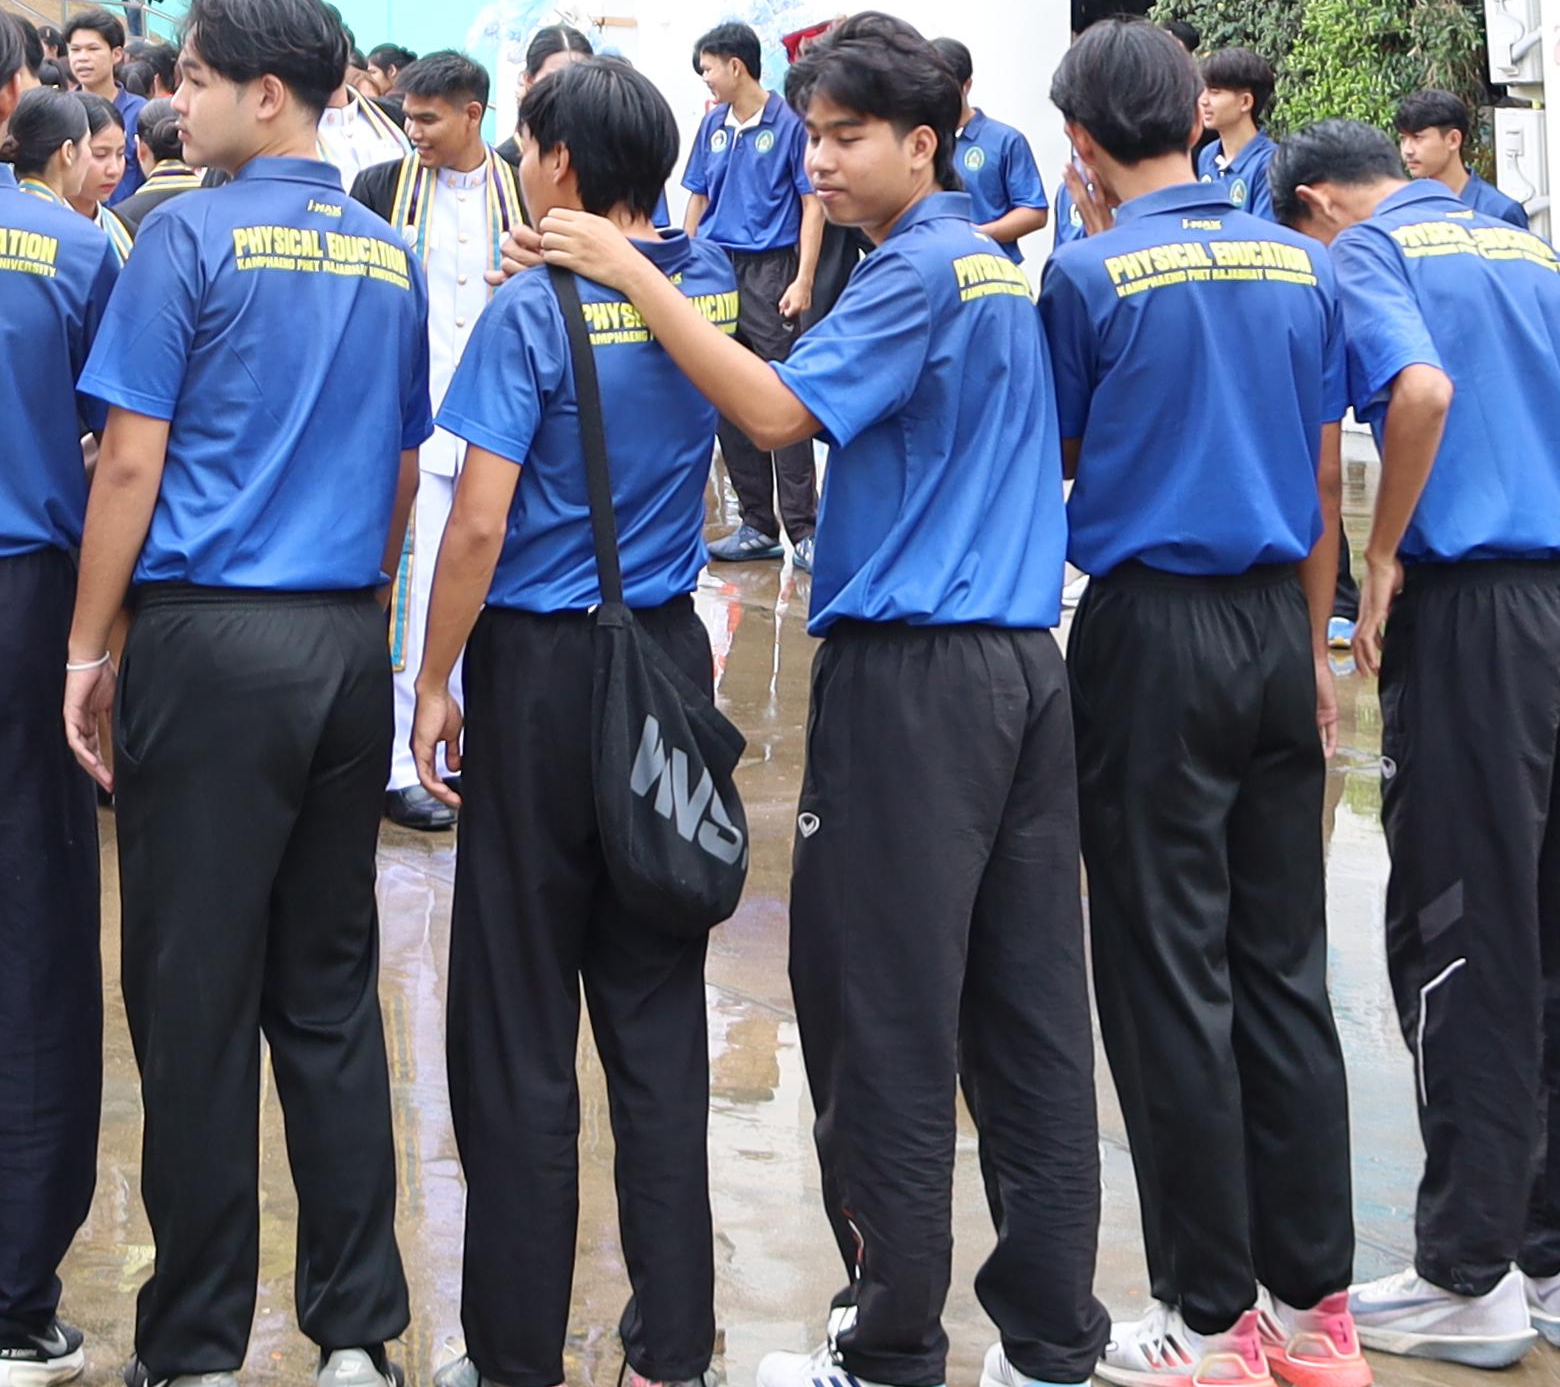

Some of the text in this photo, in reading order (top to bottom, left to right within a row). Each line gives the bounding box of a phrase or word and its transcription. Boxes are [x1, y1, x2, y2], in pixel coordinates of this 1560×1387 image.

[232, 226, 409, 278] PHYSICAL EDUCATION
[1104, 240, 1313, 285] PHYSICAL EDUCATION
[589, 330, 648, 346] AMPHAENG
